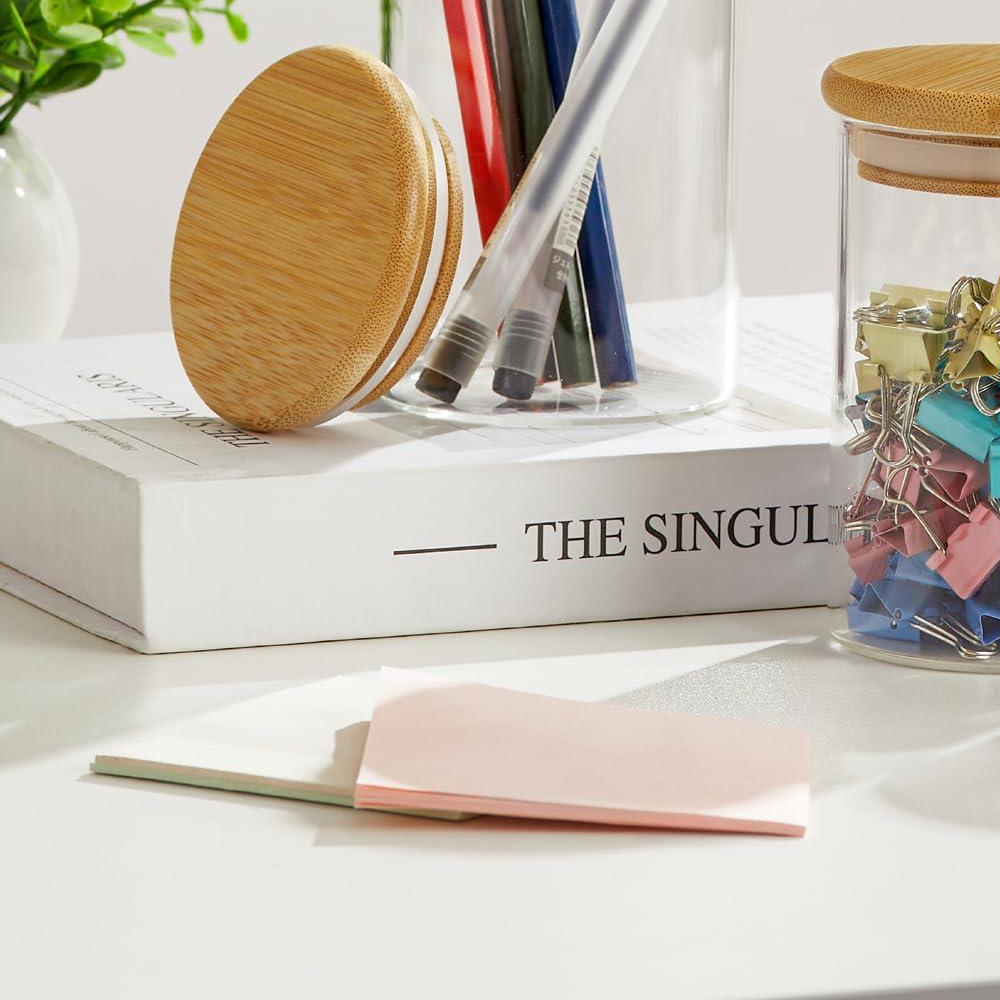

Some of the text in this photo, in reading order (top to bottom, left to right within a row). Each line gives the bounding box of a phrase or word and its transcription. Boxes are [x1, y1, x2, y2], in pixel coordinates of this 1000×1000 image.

[200, 428, 271, 448] THE
[524, 503, 829, 563] THE SINGUL
